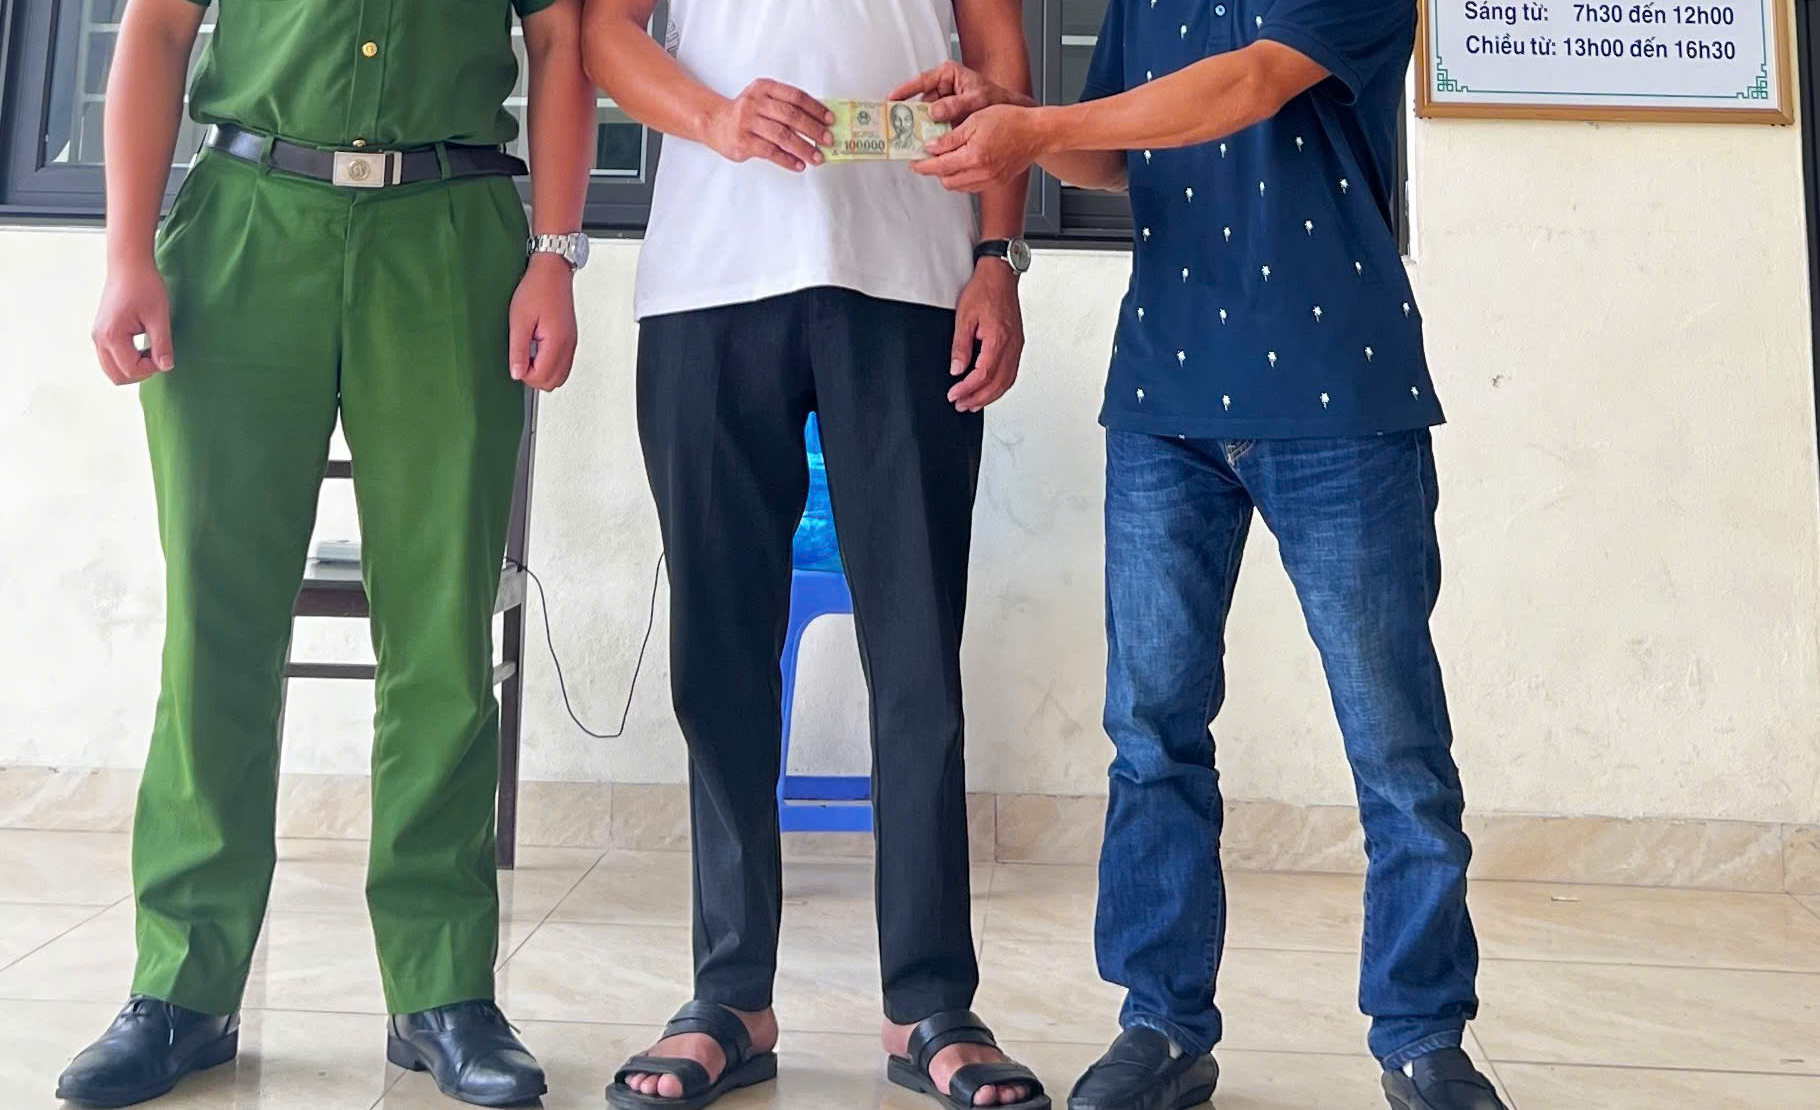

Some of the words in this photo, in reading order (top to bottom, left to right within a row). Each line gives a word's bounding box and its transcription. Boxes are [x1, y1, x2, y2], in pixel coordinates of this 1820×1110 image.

[1464, 0, 1517, 26] Sáng
[1521, 1, 1549, 22] từ:
[1573, 3, 1623, 24] 7h30
[1628, 1, 1666, 24] đến
[1672, 5, 1734, 26] 12h00
[1465, 32, 1525, 55] Chiều
[1529, 36, 1557, 56] từ:
[1563, 37, 1624, 58] 13h00
[1629, 36, 1668, 59] đến
[1674, 39, 1736, 60] 16h30
[844, 138, 886, 151] 100000
